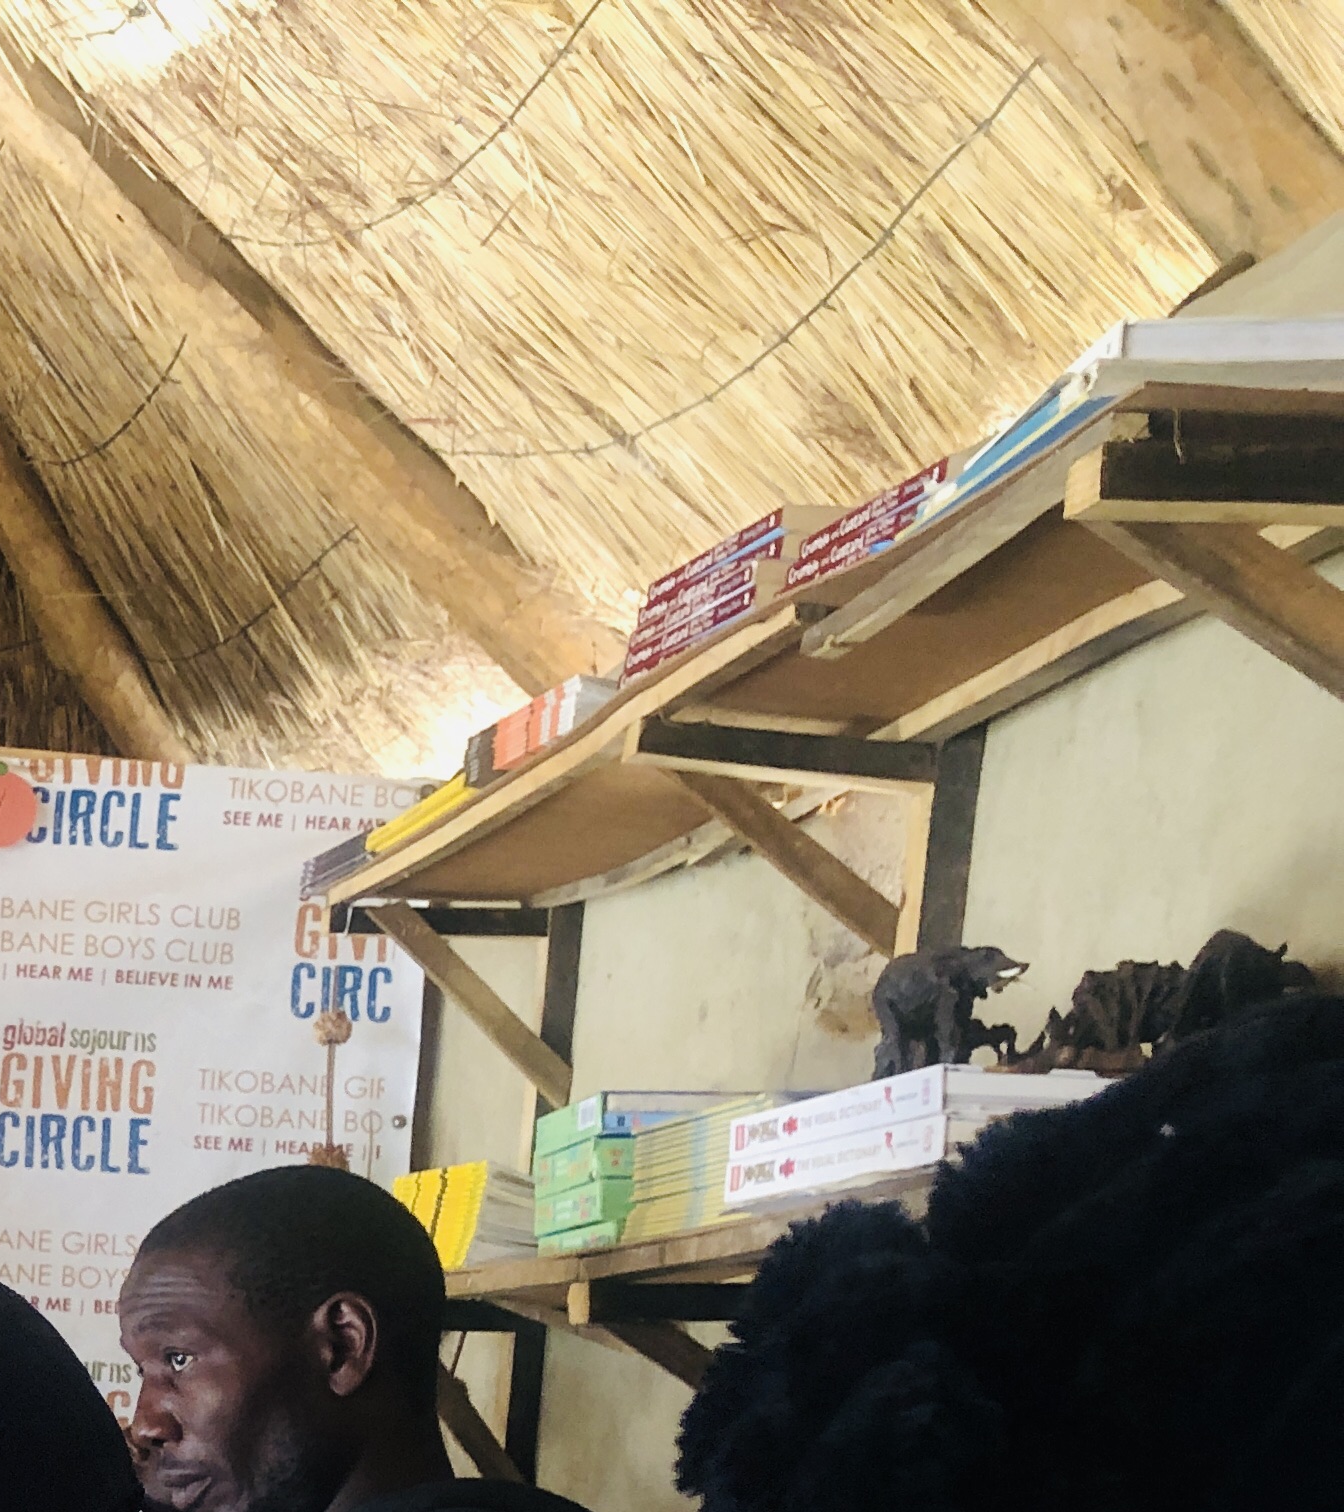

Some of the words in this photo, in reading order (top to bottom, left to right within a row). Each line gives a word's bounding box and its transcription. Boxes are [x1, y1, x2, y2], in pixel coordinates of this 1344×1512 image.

[229, 777, 365, 808] TIKOBANE
[26, 786, 181, 850] CIRCLE
[223, 810, 252, 826] SEE
[257, 813, 283, 828] ME
[305, 814, 352, 831] HEAR
[83, 900, 161, 926] GIRLS
[170, 904, 241, 931] CLUB
[83, 935, 156, 961] BOYS
[164, 938, 235, 965] CLUB
[16, 963, 62, 980] HEAR
[68, 966, 94, 982] ME
[115, 969, 179, 987] BELIEVE
[184, 974, 202, 988] IN
[208, 975, 234, 990] ME
[2, 1017, 65, 1050] global
[69, 1025, 156, 1055] sojourns
[0, 1052, 157, 1115] GIVING
[193, 1135, 222, 1150] SEE
[228, 1137, 254, 1152] ME
[62, 1231, 141, 1257] GIRLS
[45, 1298, 72, 1313] ME
